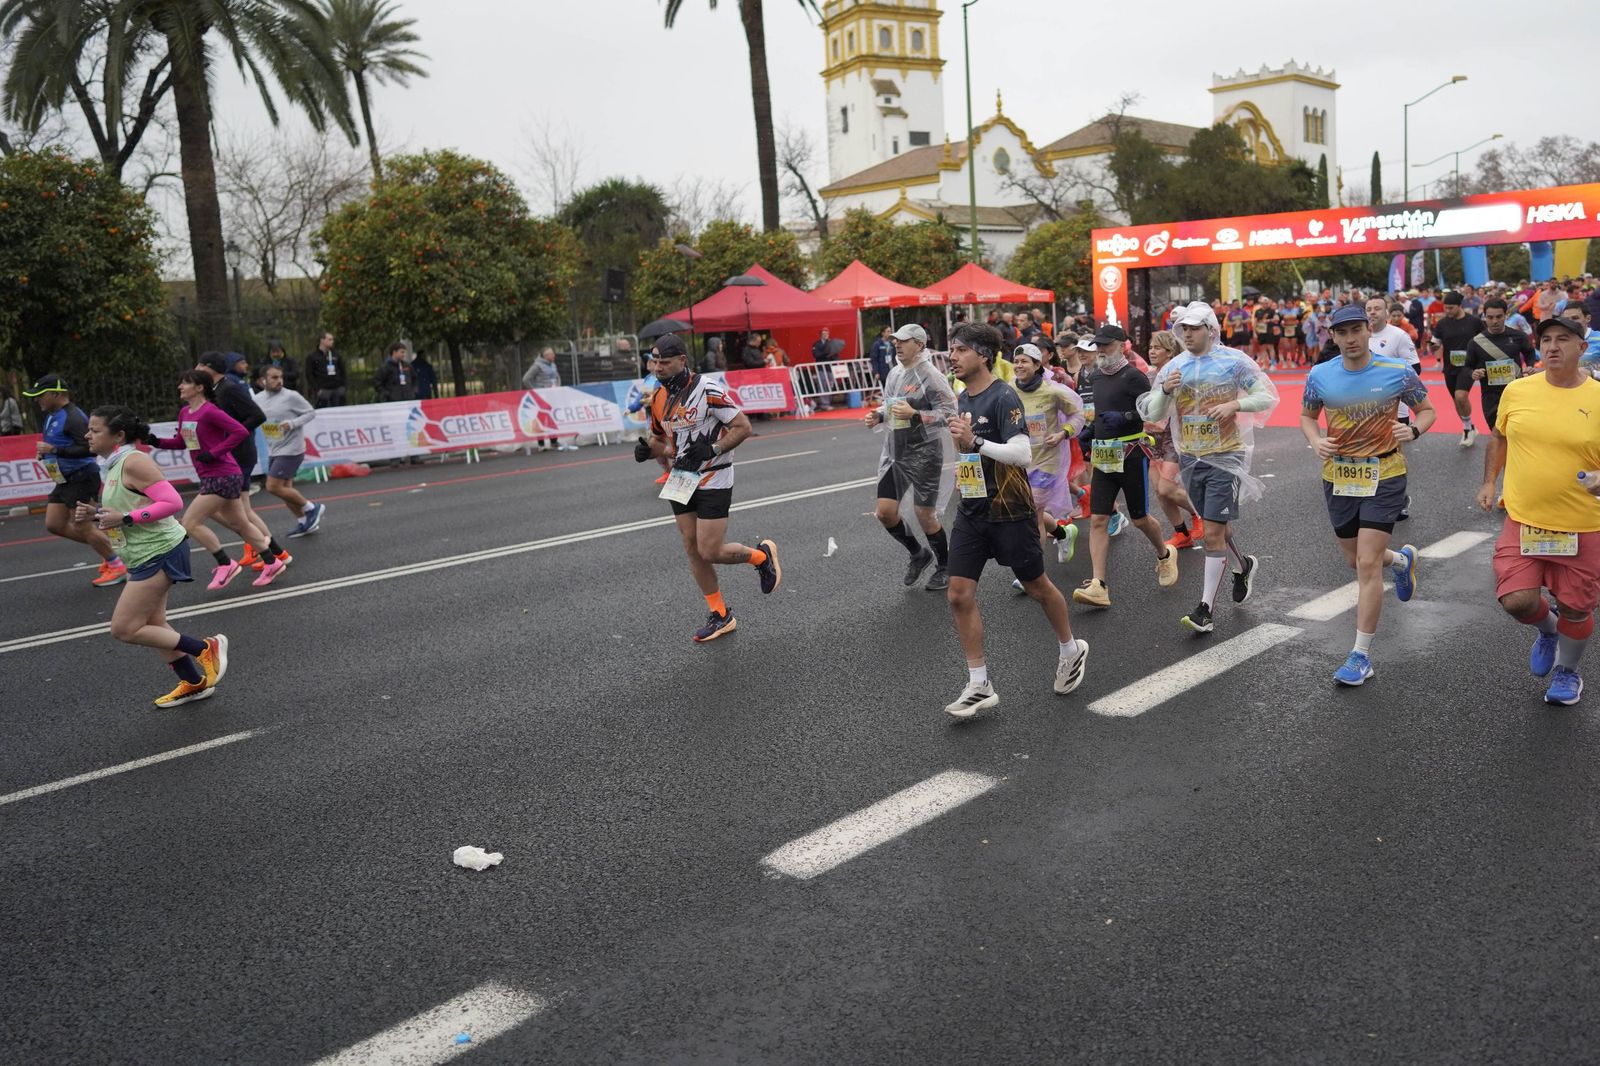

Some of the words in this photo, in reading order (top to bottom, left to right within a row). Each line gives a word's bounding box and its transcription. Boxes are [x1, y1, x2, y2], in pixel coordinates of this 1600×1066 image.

[1526, 203, 1586, 224] HOKA
[1489, 365, 1511, 375] 14450
[739, 384, 784, 401] CREATE
[553, 403, 612, 423] CREATE
[442, 413, 510, 435] CREATE
[1185, 424, 1213, 435] 1766
[314, 425, 393, 449] CREATE
[1337, 465, 1372, 480] 18915
